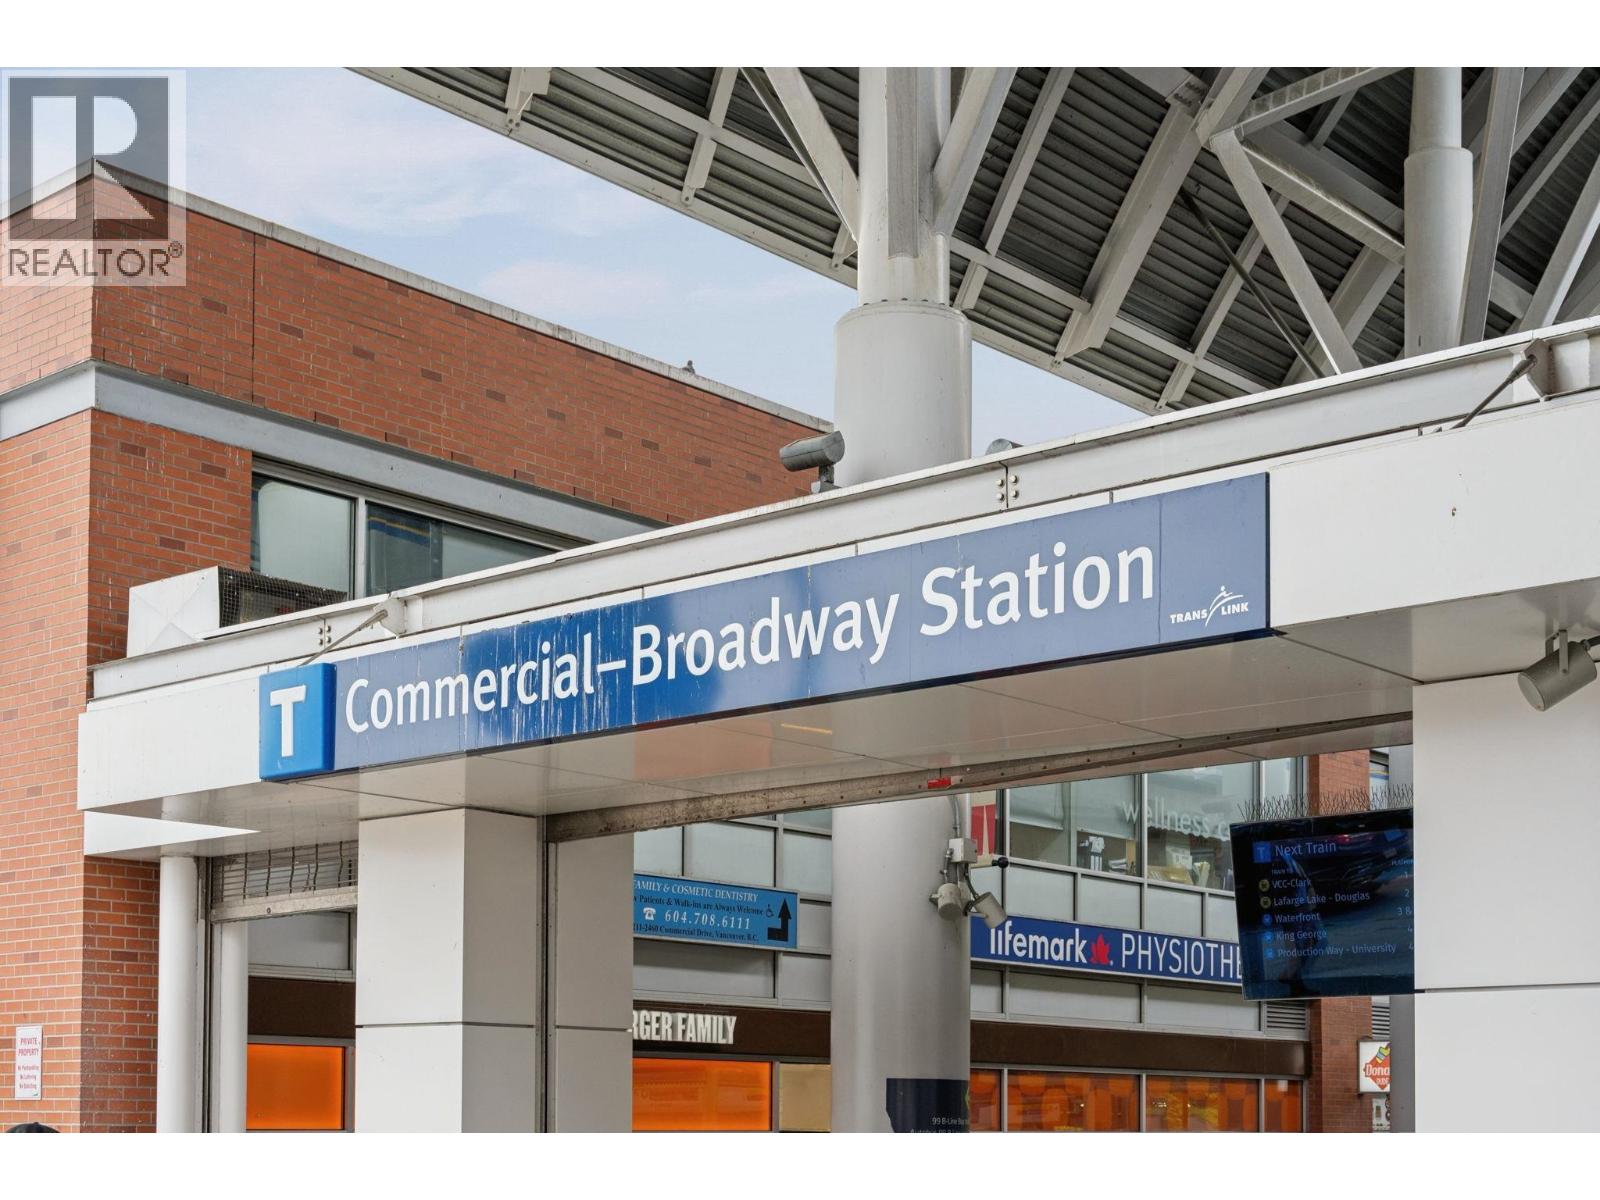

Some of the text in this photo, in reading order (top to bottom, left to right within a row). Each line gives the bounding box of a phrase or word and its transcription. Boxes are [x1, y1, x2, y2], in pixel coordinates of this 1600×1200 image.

[919, 541, 1153, 636] Station
[1170, 602, 1249, 624] TRANS LINK
[270, 685, 307, 757] T
[1275, 840, 1337, 857] Next Train
[1271, 878, 1312, 889] VCC-Clark
[640, 895, 666, 906] Patients
[663, 885, 671, 893] &
[672, 884, 714, 898] COSMETIC
[715, 888, 758, 902] DENTISTRY
[1274, 895, 1305, 907] Lafarge
[1307, 895, 1327, 904] Lake
[1335, 891, 1371, 903] Douglas
[1405, 889, 1410, 897] 2
[665, 909, 751, 929] 604.708.6111
[1275, 912, 1321, 923] Waterfront
[1397, 907, 1402, 916] 3
[1276, 930, 1327, 942] King George
[1278, 947, 1325, 958] Production
[1326, 947, 1344, 957] Way
[1352, 943, 1397, 954] University
[677, 1012, 737, 1044] FAMILY
